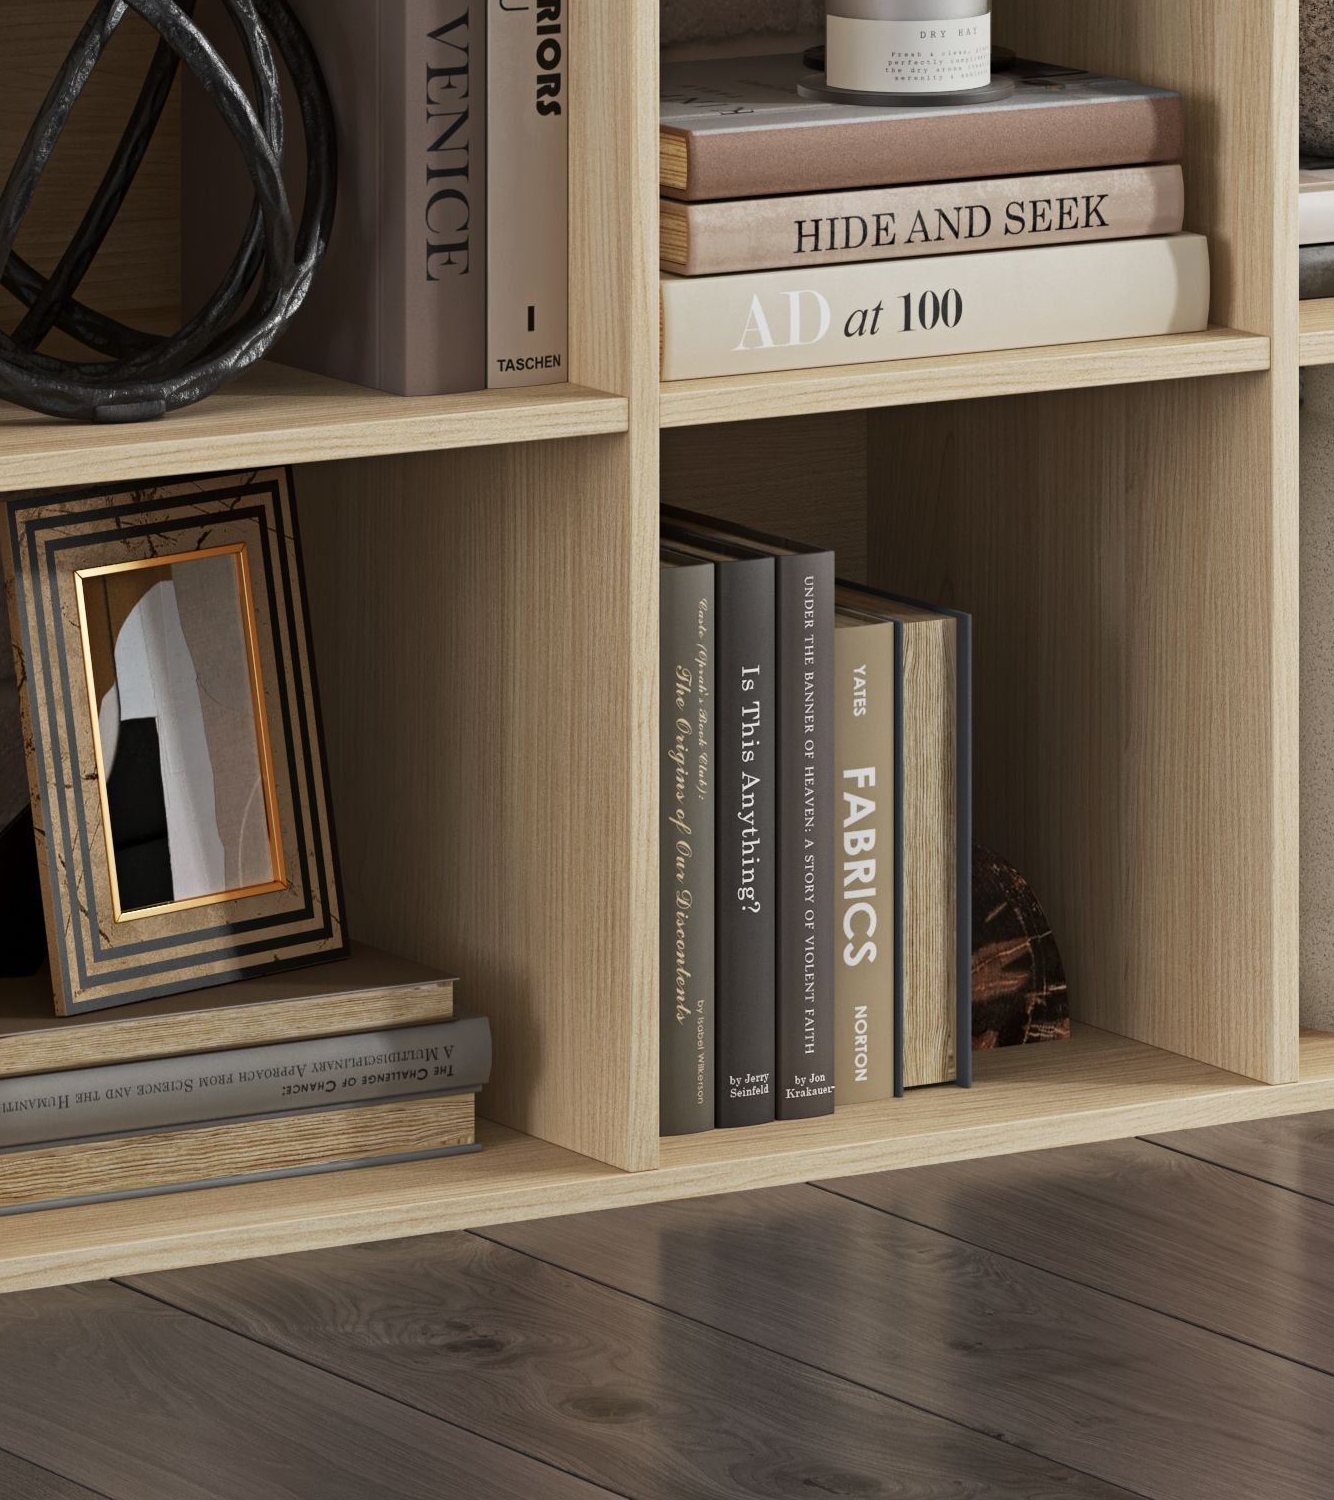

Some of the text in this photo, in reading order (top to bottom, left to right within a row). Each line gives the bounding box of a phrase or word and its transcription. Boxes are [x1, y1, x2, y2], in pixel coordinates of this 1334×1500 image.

[920, 30, 946, 39] DRY
[426, 9, 470, 281] VENICE
[793, 194, 1109, 253] HIDE AND SEEK
[731, 288, 963, 352] AD at 100
[497, 354, 561, 372] TASCHEN
[853, 664, 866, 716] YATES
[737, 664, 761, 913] Is This Anything?
[804, 576, 814, 1054] UNDER THE BANNER OF HEAVEN: A STORY OF VIOLENT FAITH
[668, 665, 692, 1025] The Origins of Our Discontents
[843, 766, 876, 966] FABRICS
[696, 1000, 704, 1014] by
[444, 1045, 454, 1059] A
[854, 1005, 867, 1081] NORTON
[697, 1053, 705, 1105] Wilkerson
[729, 1073, 769, 1087] by Jerry
[730, 1084, 769, 1098] Seinfeld
[794, 1073, 825, 1086] by Jon
